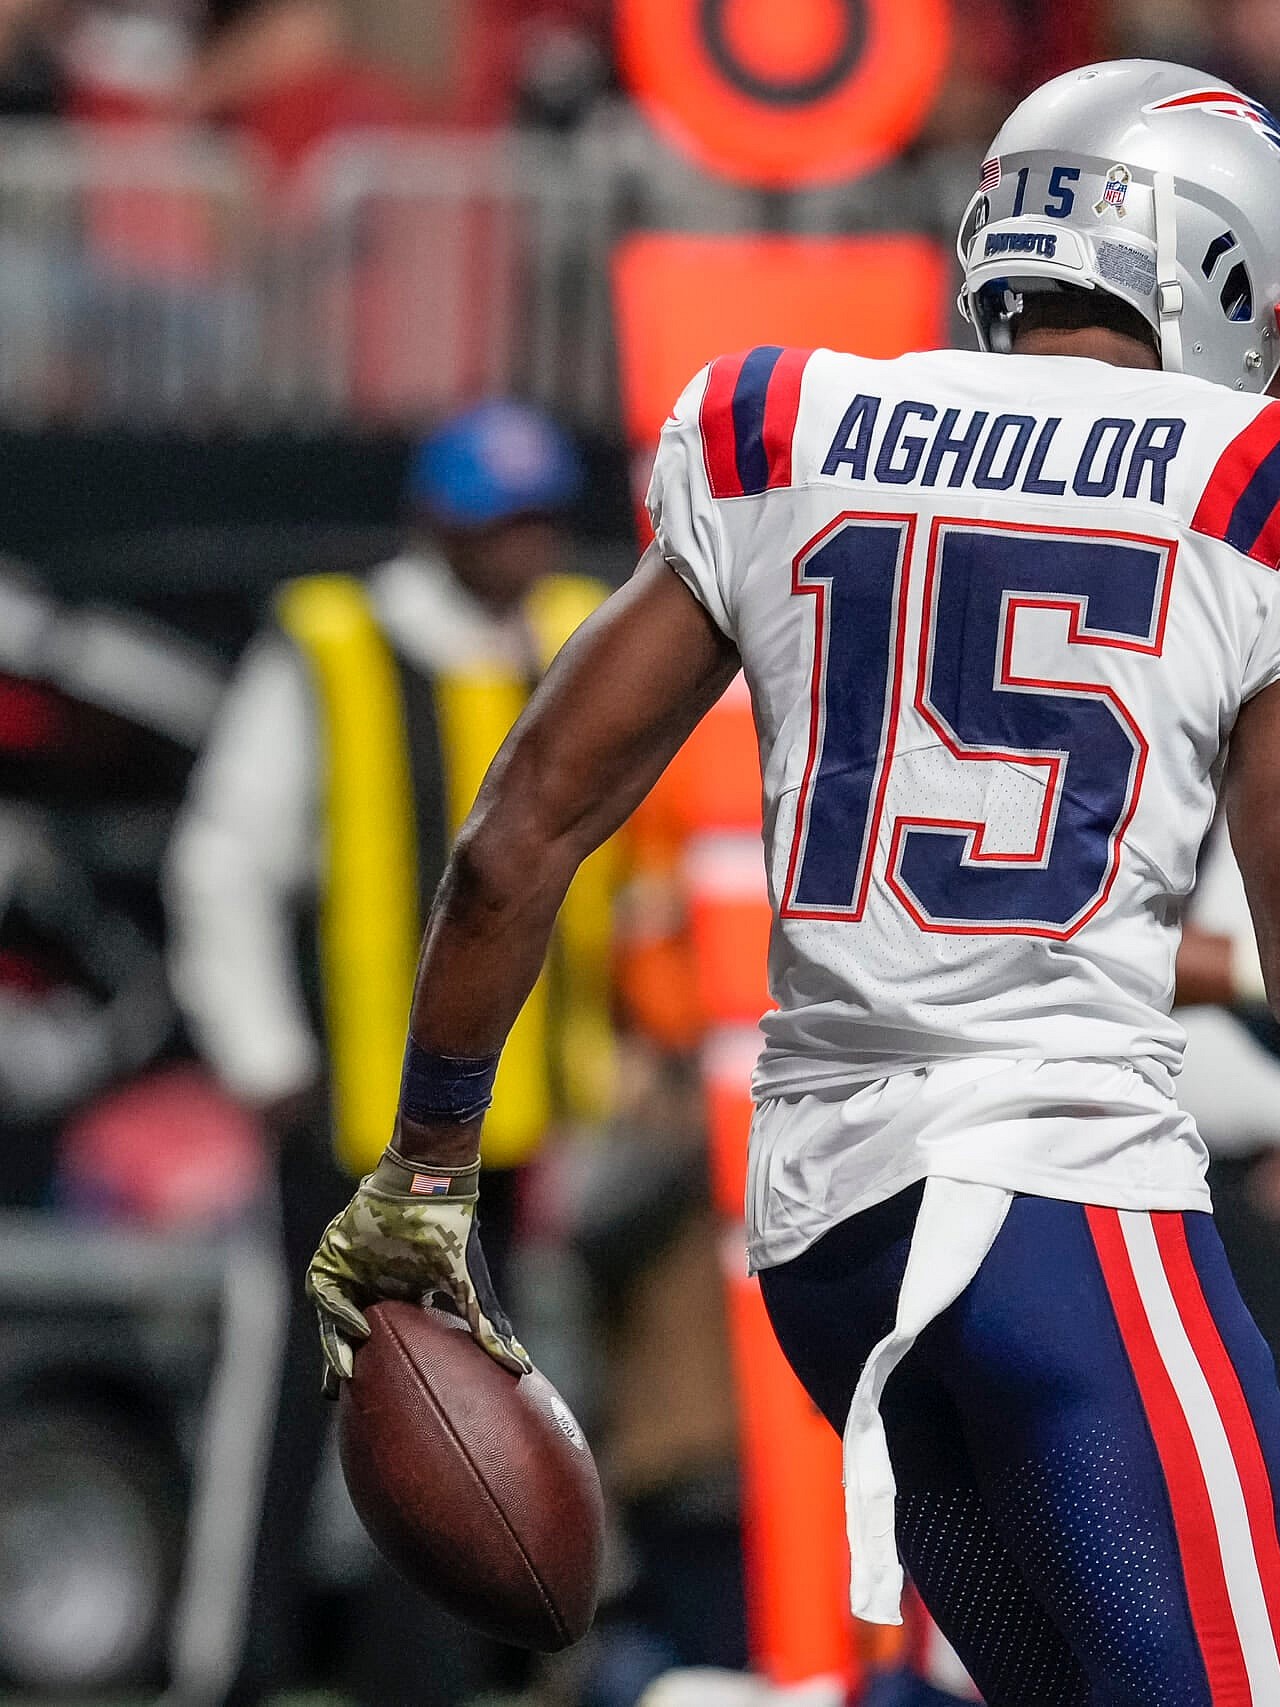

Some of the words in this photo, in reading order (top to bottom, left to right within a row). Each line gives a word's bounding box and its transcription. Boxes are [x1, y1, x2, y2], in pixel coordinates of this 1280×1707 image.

[1012, 166, 1081, 219] 15
[984, 232, 1057, 258] PATRIOTS
[820, 394, 1187, 505] AGHOLOR
[780, 510, 1179, 941] 15
